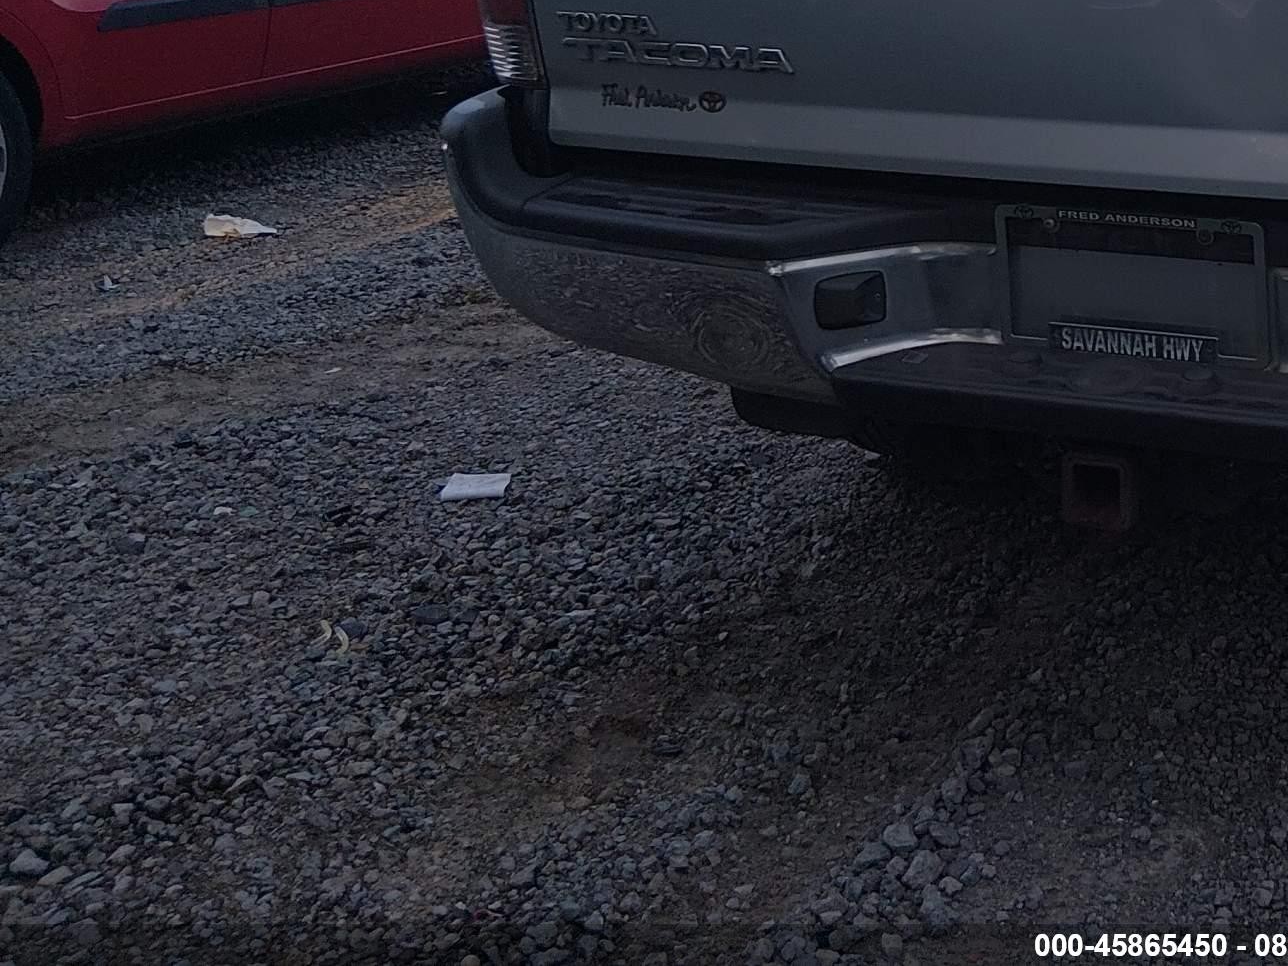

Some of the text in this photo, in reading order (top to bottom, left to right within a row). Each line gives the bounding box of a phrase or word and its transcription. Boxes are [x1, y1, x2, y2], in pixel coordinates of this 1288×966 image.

[556, 10, 657, 36] TOYOTA
[562, 36, 794, 74] TACOMA
[1058, 210, 1196, 228] FRED ANDERSON
[1061, 327, 1204, 362] SAVANNAH HWY
